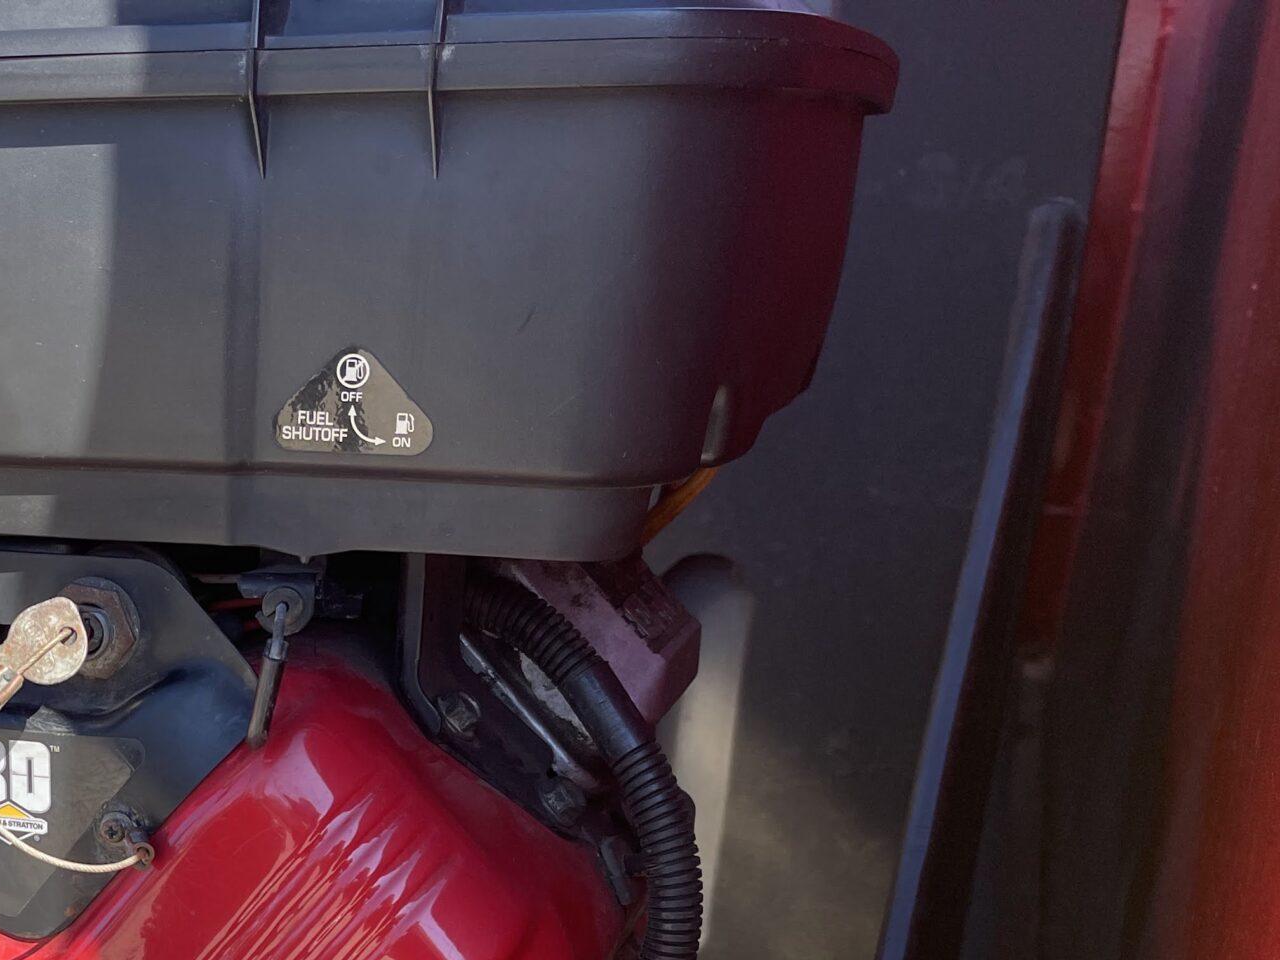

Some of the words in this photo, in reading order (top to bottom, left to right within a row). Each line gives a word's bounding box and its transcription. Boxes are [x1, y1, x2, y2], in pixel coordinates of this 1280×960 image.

[340, 391, 363, 403] OFF
[297, 410, 334, 426] FUEL
[282, 425, 349, 443] SHUTOFF
[392, 437, 412, 448] ON
[8, 819, 44, 831] STRATTON
